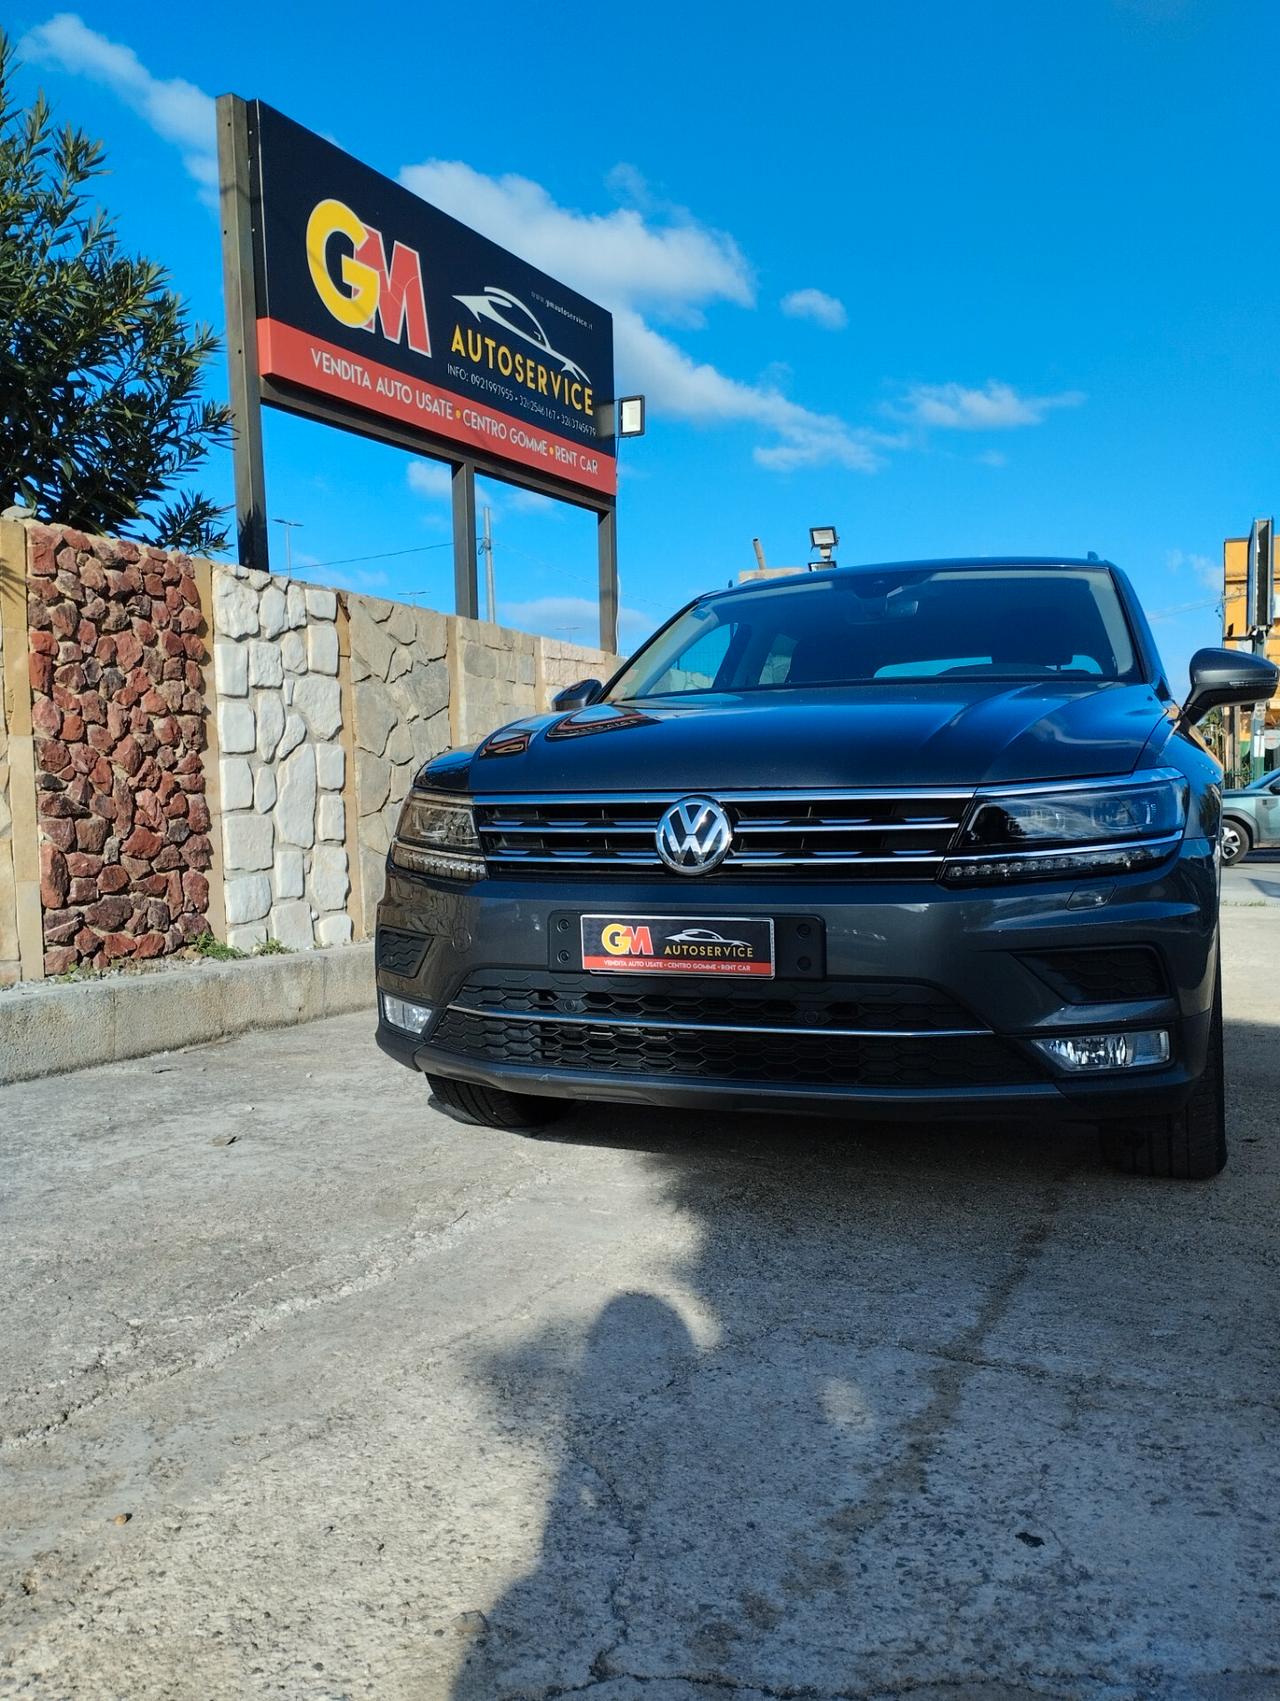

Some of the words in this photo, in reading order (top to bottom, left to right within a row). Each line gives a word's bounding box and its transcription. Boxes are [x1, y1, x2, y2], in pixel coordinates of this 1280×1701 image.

[306, 199, 432, 358] GM
[447, 363, 469, 382] INFO:
[451, 323, 594, 416] AUTOSERVICE
[310, 347, 372, 389] VENDITA
[376, 376, 413, 404] AUTO
[416, 389, 454, 420] USATE
[462, 408, 507, 440] CENTRO
[509, 428, 548, 456] GOMME
[555, 445, 578, 467] RENT
[579, 455, 599, 475] CAR
[601, 923, 654, 956] GM
[664, 945, 754, 958] AUTOSERVICE
[604, 959, 627, 967] VENDITA
[628, 960, 645, 968] AUTO
[645, 961, 663, 969] USATE
[667, 962, 691, 970] CENTRO
[737, 964, 751, 972] CAR
